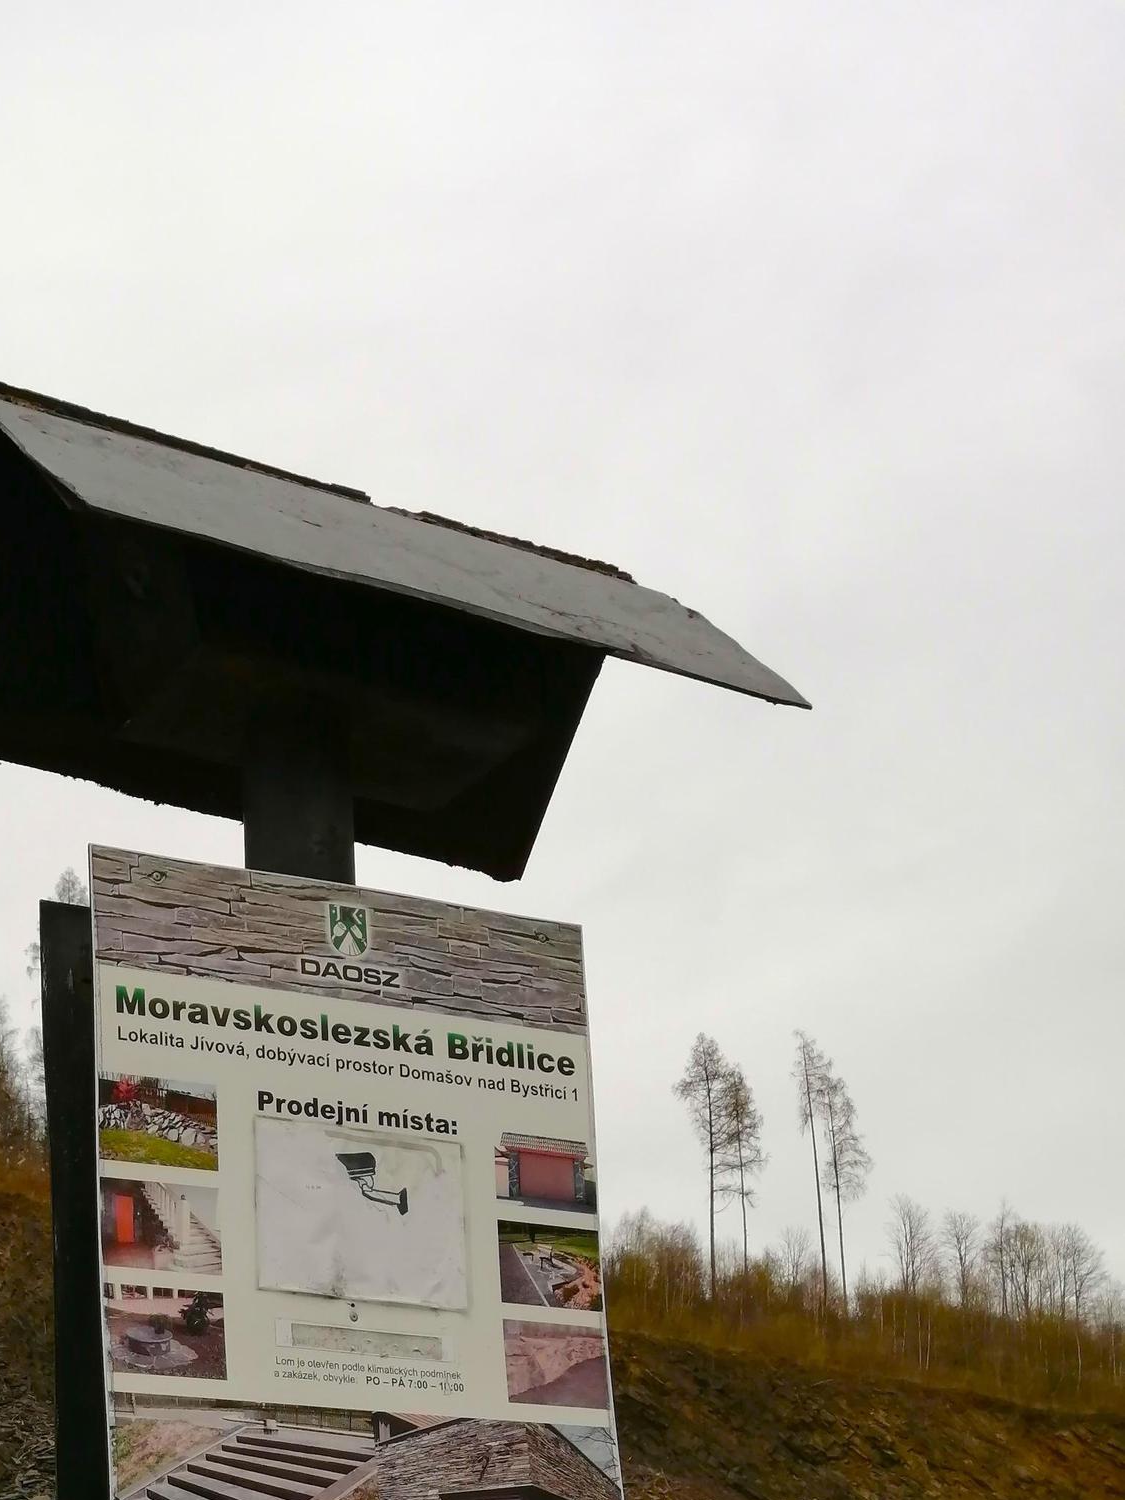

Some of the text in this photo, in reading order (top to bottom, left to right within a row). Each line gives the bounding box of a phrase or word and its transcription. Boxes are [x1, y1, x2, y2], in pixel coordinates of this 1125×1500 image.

[300, 958, 401, 989] DAOSZ
[115, 984, 576, 1076] Moravskoslezská Břidlice
[118, 1025, 579, 1102] Lokalita Jívová, dobývací prostor Domašov nad Bystřicí 1
[257, 1090, 458, 1136] Prodejní místa:
[274, 1370, 280, 1378] a
[365, 1375, 381, 1386] PO
[391, 1376, 406, 1389] PÁ
[408, 1379, 428, 1390] 7:00
[275, 1355, 296, 1367] Lom
[297, 1356, 306, 1370] je
[342, 1361, 365, 1373] podle
[367, 1362, 418, 1379] klimatických
